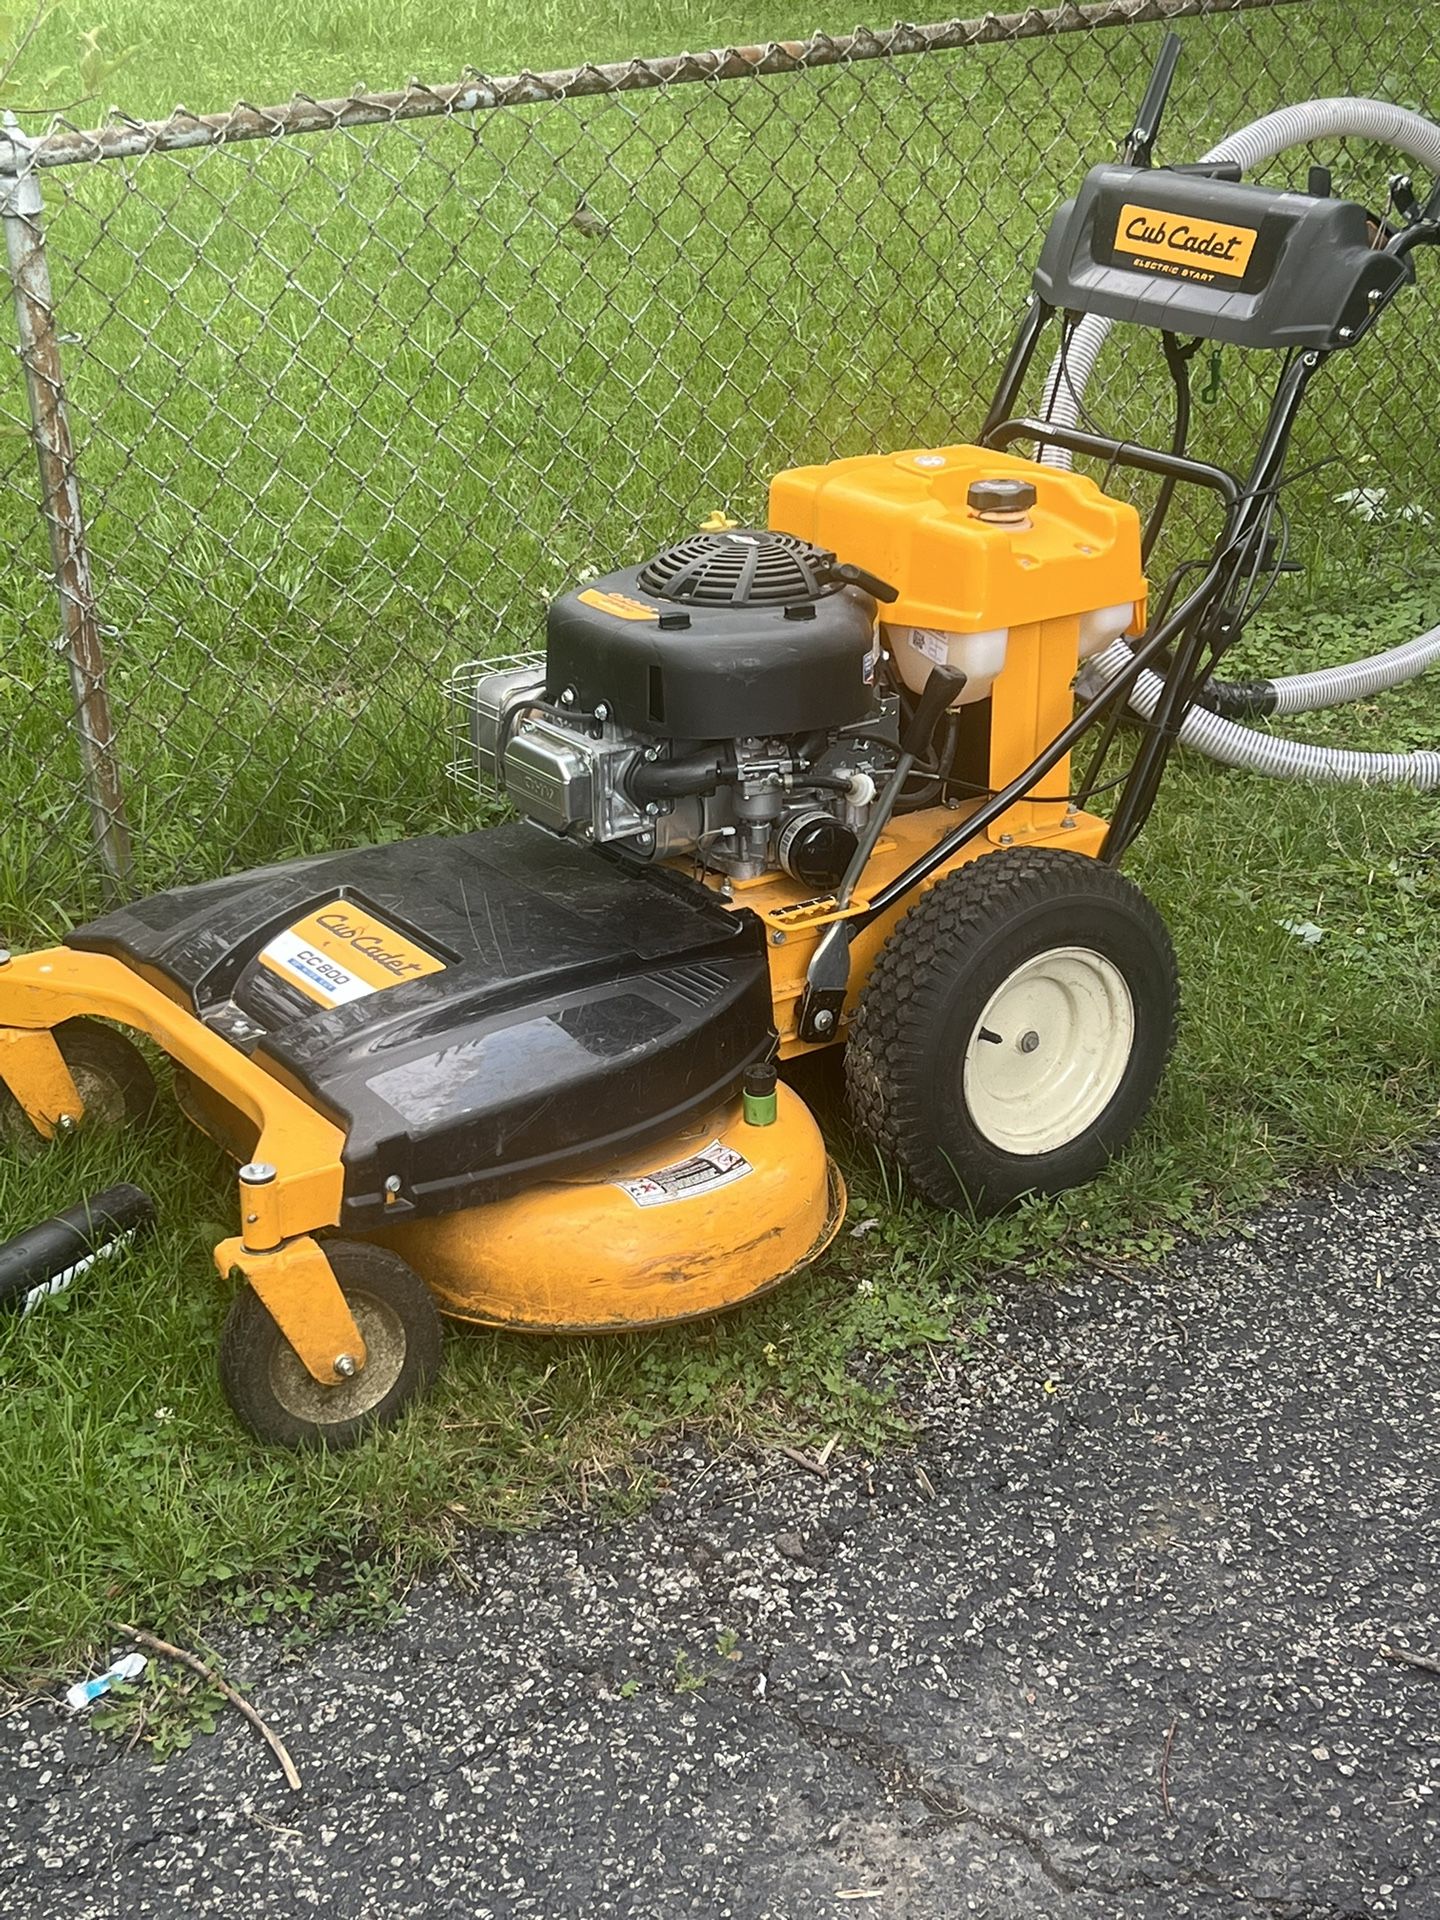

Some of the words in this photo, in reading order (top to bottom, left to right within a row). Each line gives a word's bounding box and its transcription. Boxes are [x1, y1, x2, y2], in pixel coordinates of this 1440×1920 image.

[1125, 217, 1167, 245] Cub
[1167, 226, 1242, 261] Cadet
[1133, 258, 1180, 275] ELECTRIC
[1181, 270, 1215, 283] START
[315, 914, 357, 939] Cub
[350, 936, 422, 977] Cadet
